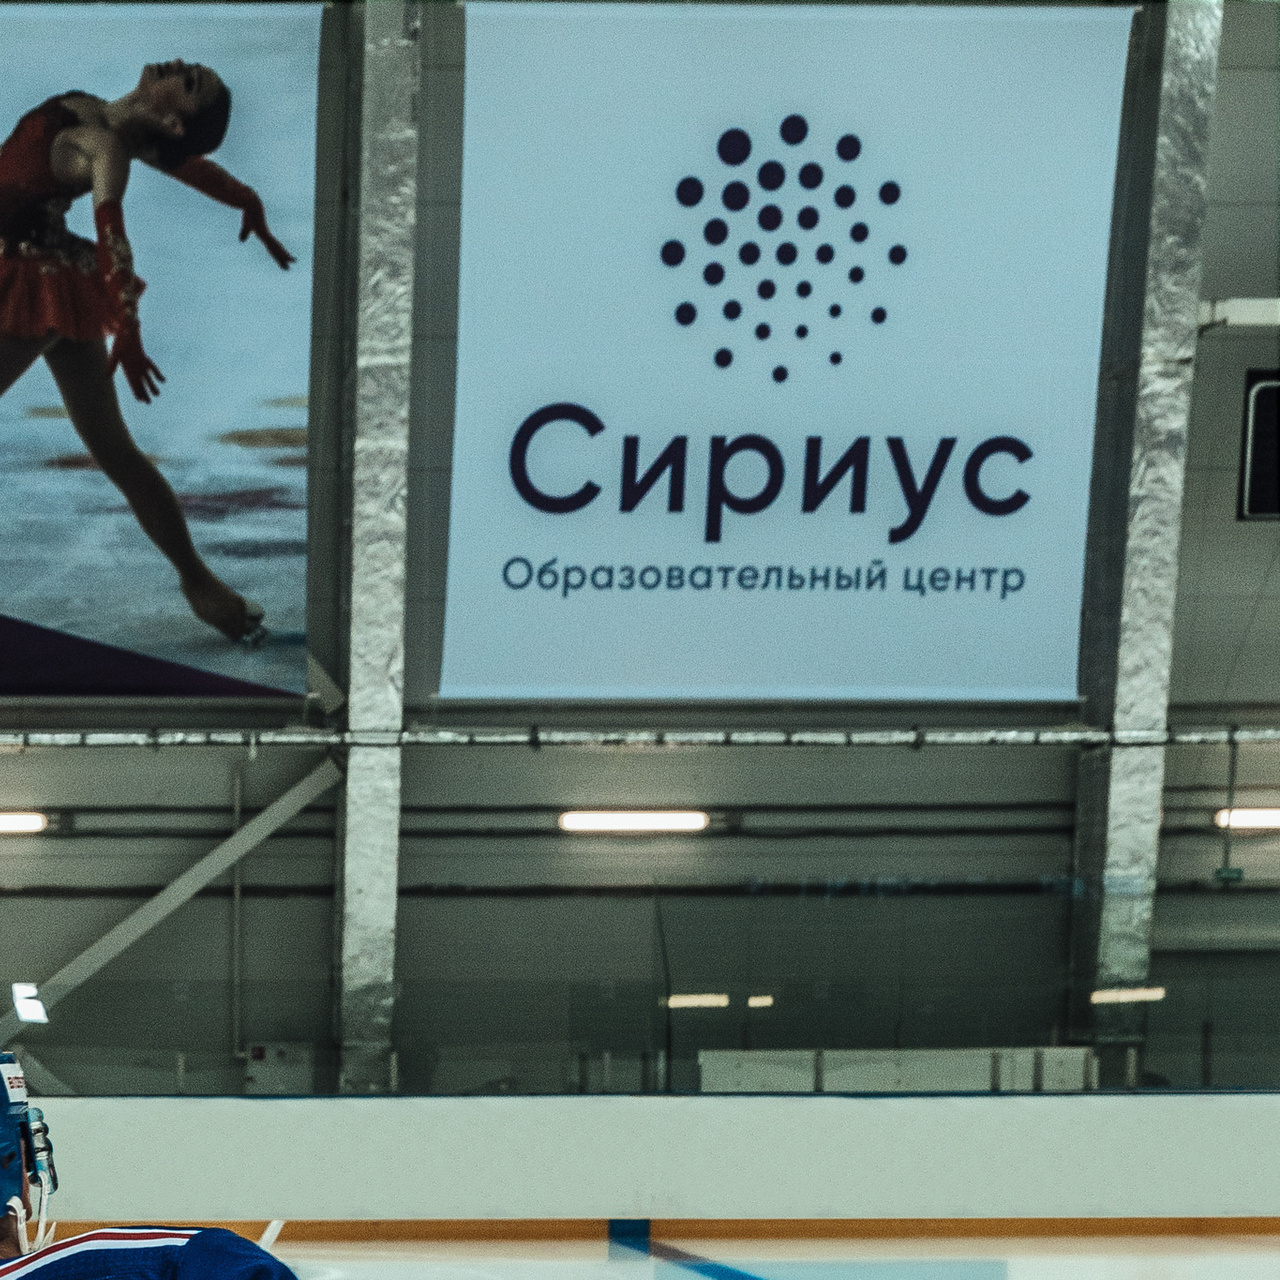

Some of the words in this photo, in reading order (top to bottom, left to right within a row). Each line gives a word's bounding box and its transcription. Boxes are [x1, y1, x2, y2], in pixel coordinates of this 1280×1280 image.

[508, 402, 1034, 544] Сириус
[502, 555, 887, 598] Образовательный
[903, 564, 1026, 600] центр
